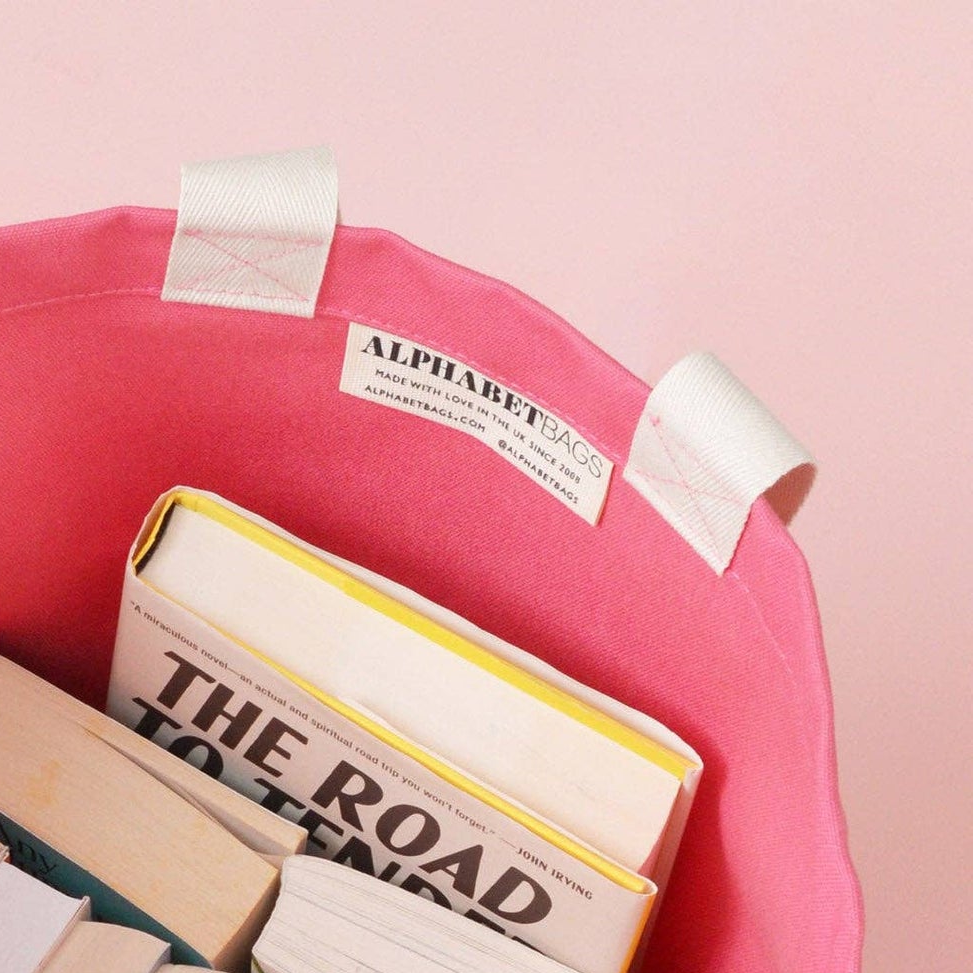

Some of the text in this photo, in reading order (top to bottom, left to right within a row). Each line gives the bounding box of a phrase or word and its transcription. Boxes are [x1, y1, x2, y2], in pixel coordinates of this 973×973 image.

[360, 335, 603, 479] ALPHABETBAGS
[364, 384, 579, 505] ALPHABETBAGS.COM @ALPHABETBAGS
[375, 369, 581, 485] MADE WITH LOVE IN THE UK SINCE 2008
[131, 697, 546, 956] TO TEN
[143, 611, 199, 651] miraculous
[255, 683, 287, 707] actual
[289, 703, 309, 722] and
[311, 718, 353, 752] spiritual
[355, 747, 379, 765] road
[381, 761, 399, 778] trip
[402, 776, 421, 793] you
[423, 789, 453, 812] won’t
[551, 868, 593, 901] IRVING
[154, 651, 553, 925] THE ROAD
